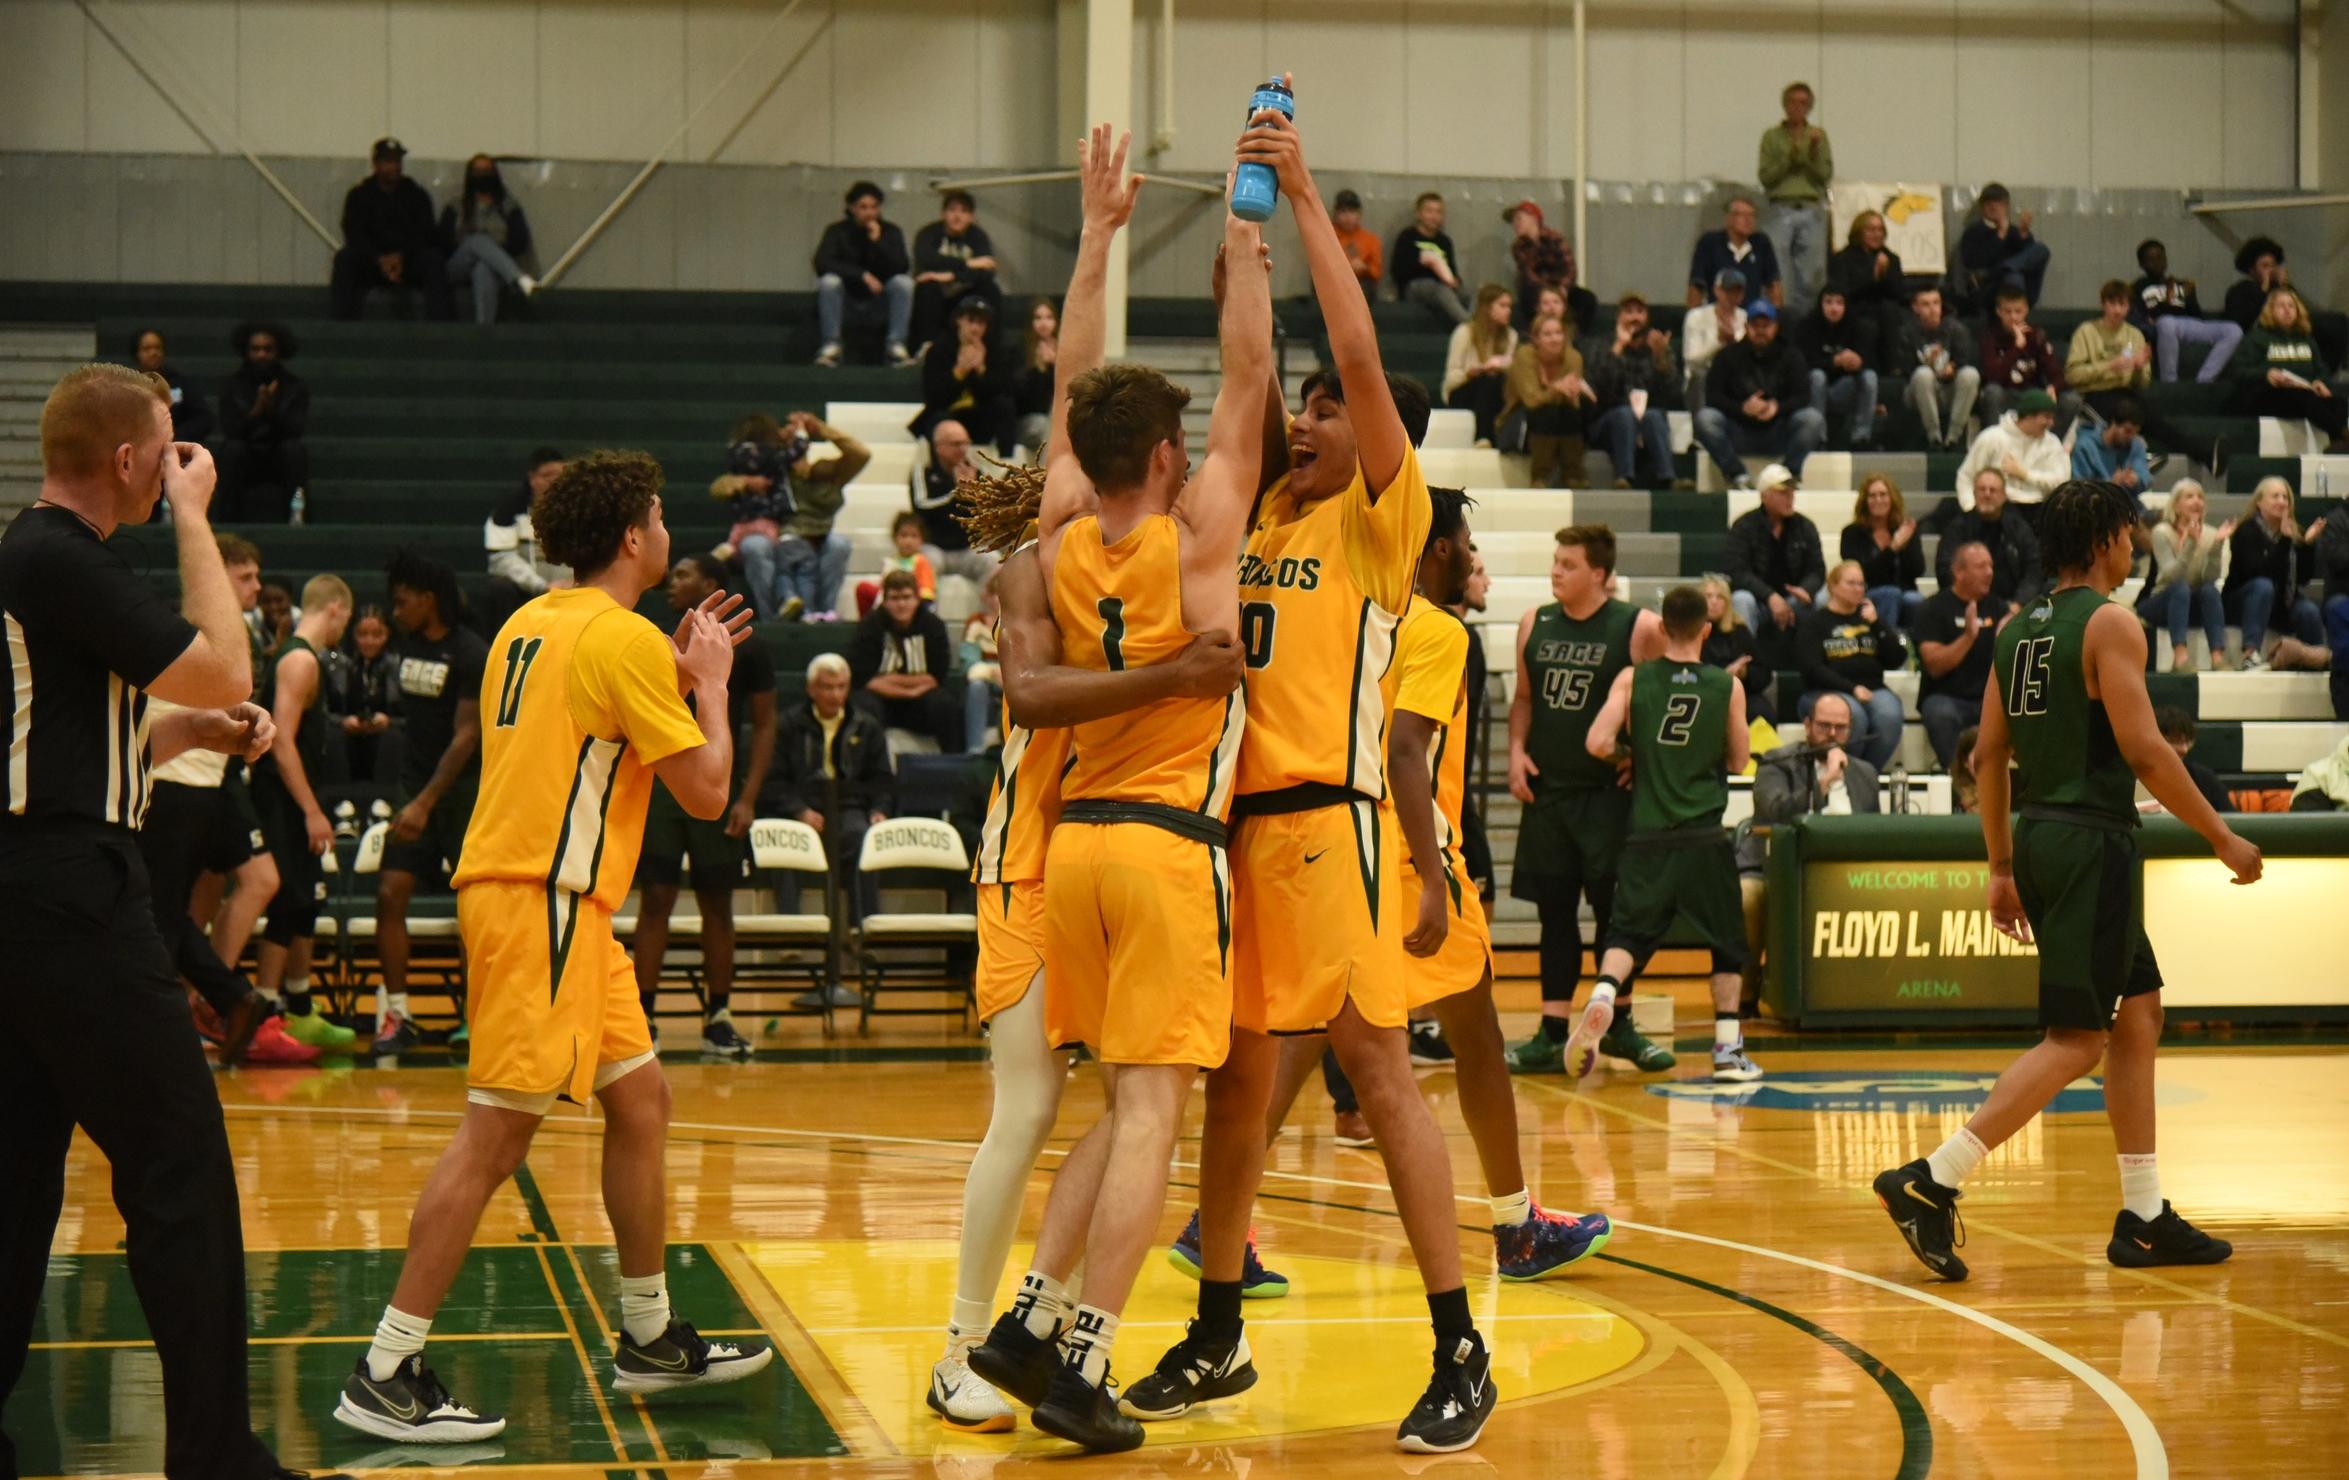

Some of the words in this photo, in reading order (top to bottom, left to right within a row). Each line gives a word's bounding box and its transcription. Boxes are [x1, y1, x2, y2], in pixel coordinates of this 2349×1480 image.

[1096, 595, 1127, 672] 1
[1238, 600, 1278, 671] 0
[1536, 639, 1607, 666] SAGE
[496, 635, 544, 728] 11
[1542, 668, 1594, 711] 45
[2008, 635, 2055, 717] 15
[1656, 693, 1701, 746] 2
[874, 827, 951, 852] BRONCOS
[1848, 870, 1938, 889] WELCOME
[1947, 870, 1971, 889] TO
[1812, 910, 1900, 958] FLOYD
[1906, 910, 1931, 957] L.
[1897, 981, 1962, 998] ARENA
